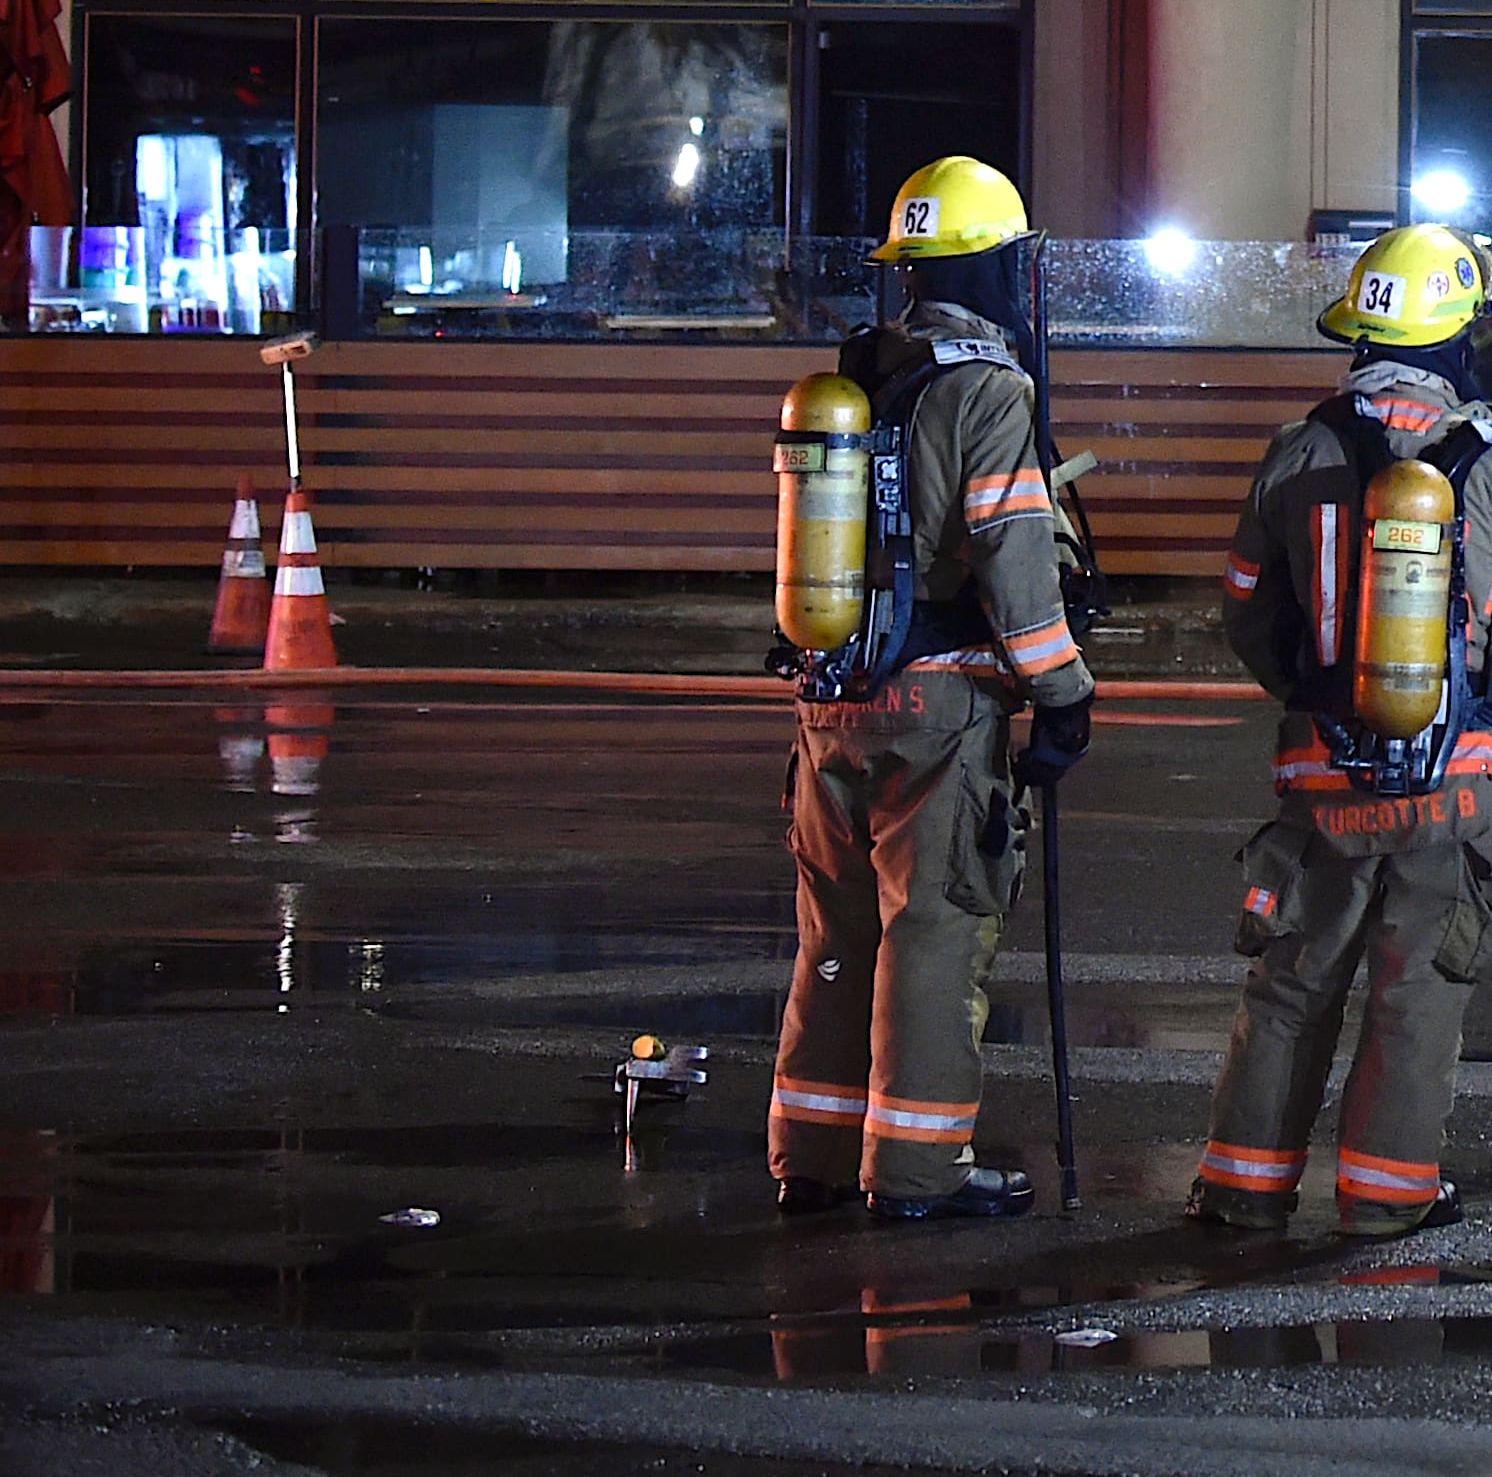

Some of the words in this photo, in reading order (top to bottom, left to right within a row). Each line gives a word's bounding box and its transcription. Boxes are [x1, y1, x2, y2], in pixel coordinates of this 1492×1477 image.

[905, 201, 930, 235] 62
[1365, 278, 1394, 314] 34
[781, 450, 809, 465] 262
[1387, 526, 1425, 544] 262
[1312, 792, 1448, 837] TURCOTTE
